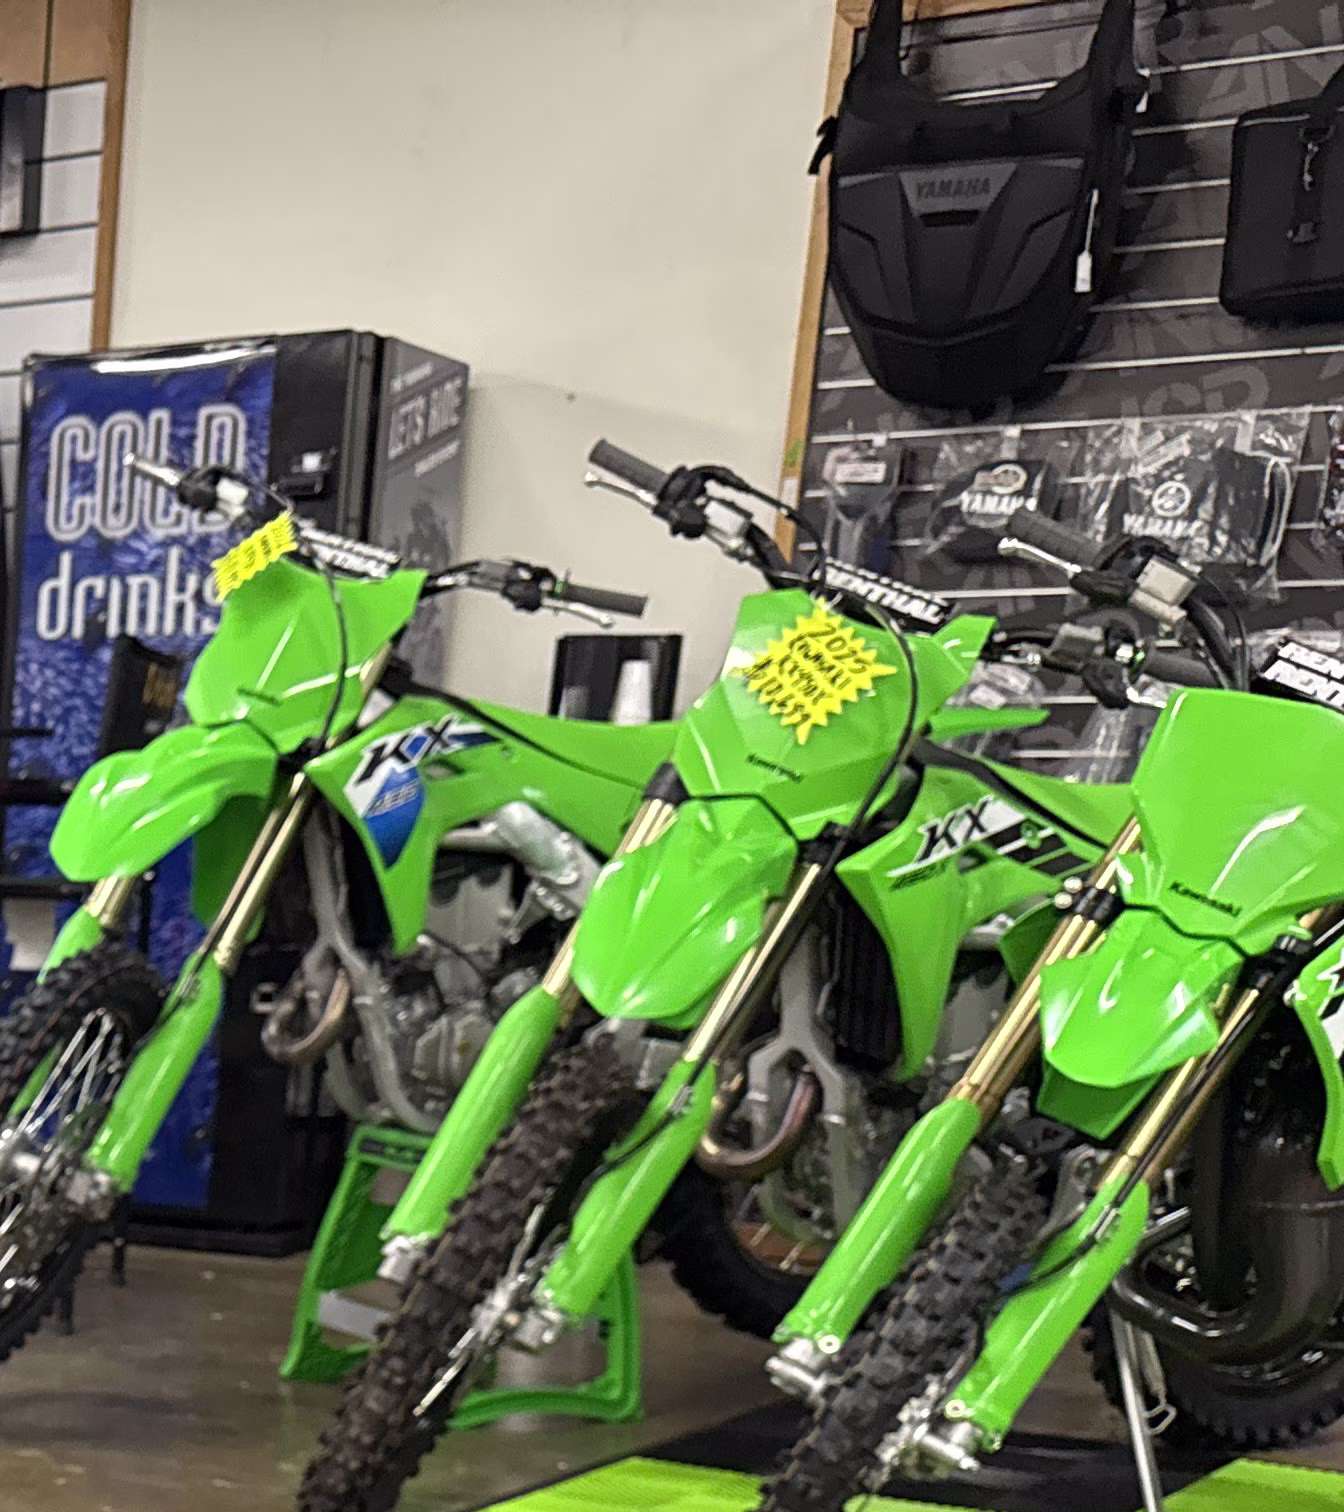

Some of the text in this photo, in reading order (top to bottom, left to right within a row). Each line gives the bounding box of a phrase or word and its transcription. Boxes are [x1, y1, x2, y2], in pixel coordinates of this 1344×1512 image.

[45, 402, 250, 543] COLD
[355, 718, 454, 787] KX
[916, 798, 993, 864] KX
